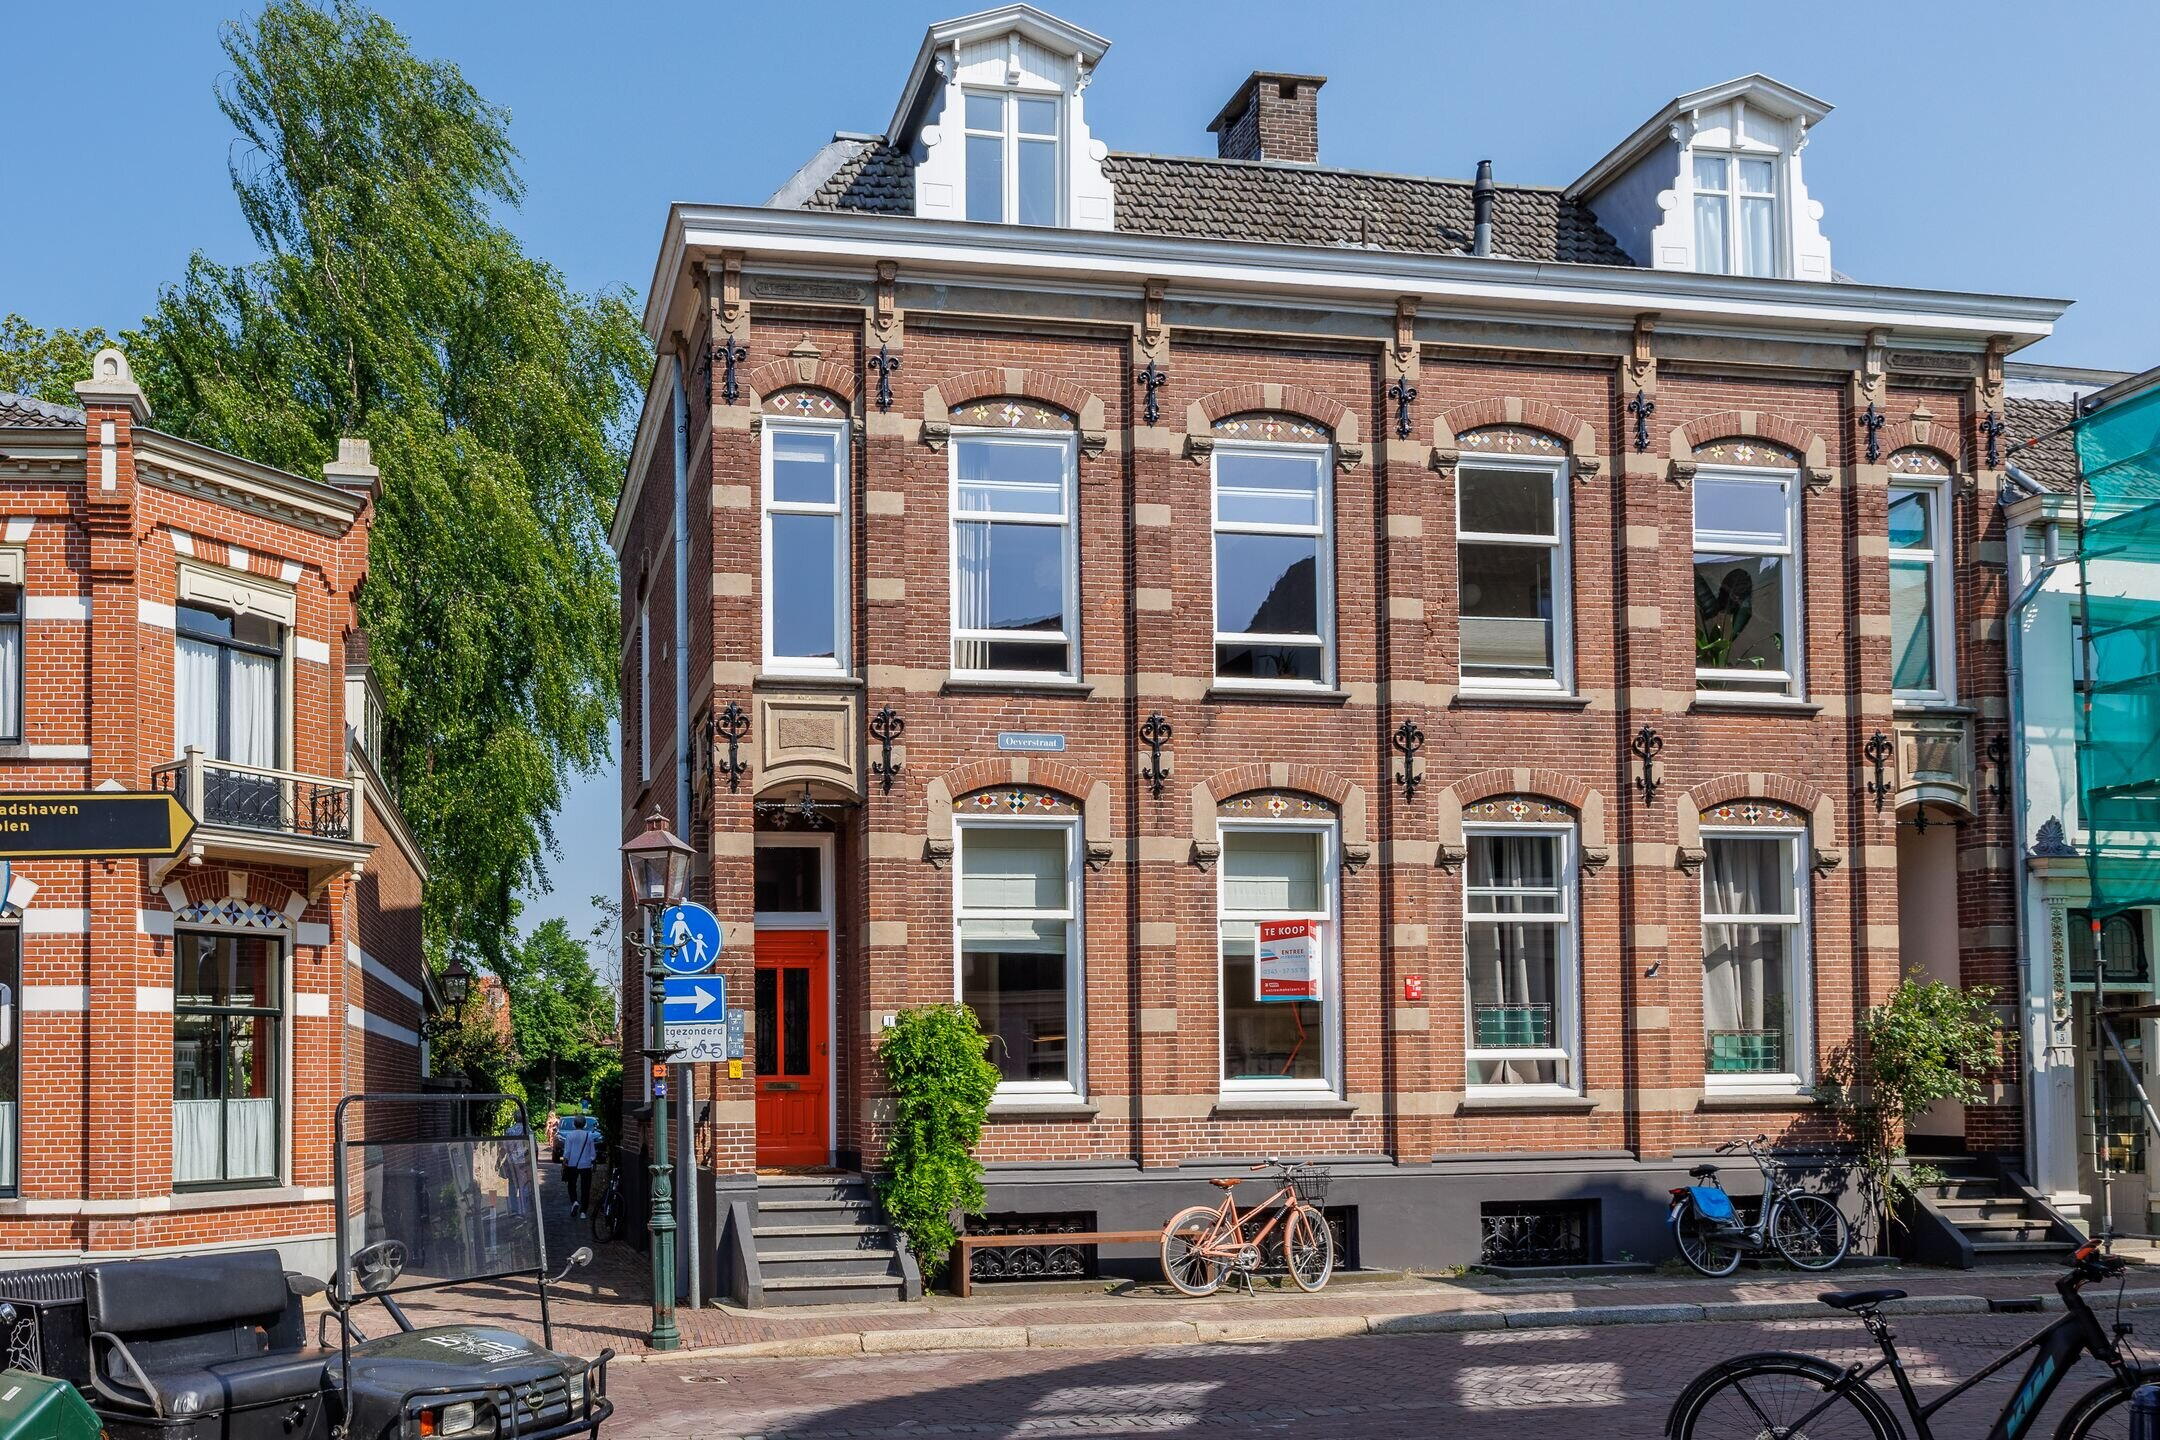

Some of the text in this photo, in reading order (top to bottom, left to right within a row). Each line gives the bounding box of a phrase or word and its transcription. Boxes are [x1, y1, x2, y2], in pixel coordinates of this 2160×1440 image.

[1005, 736, 1057, 747] Oeverstraat
[0, 803, 79, 815] adshaven
[0, 820, 30, 832] len
[1264, 928, 1275, 936] TE
[1278, 925, 1305, 935] KOOP
[665, 1027, 723, 1038] tgezonderd
